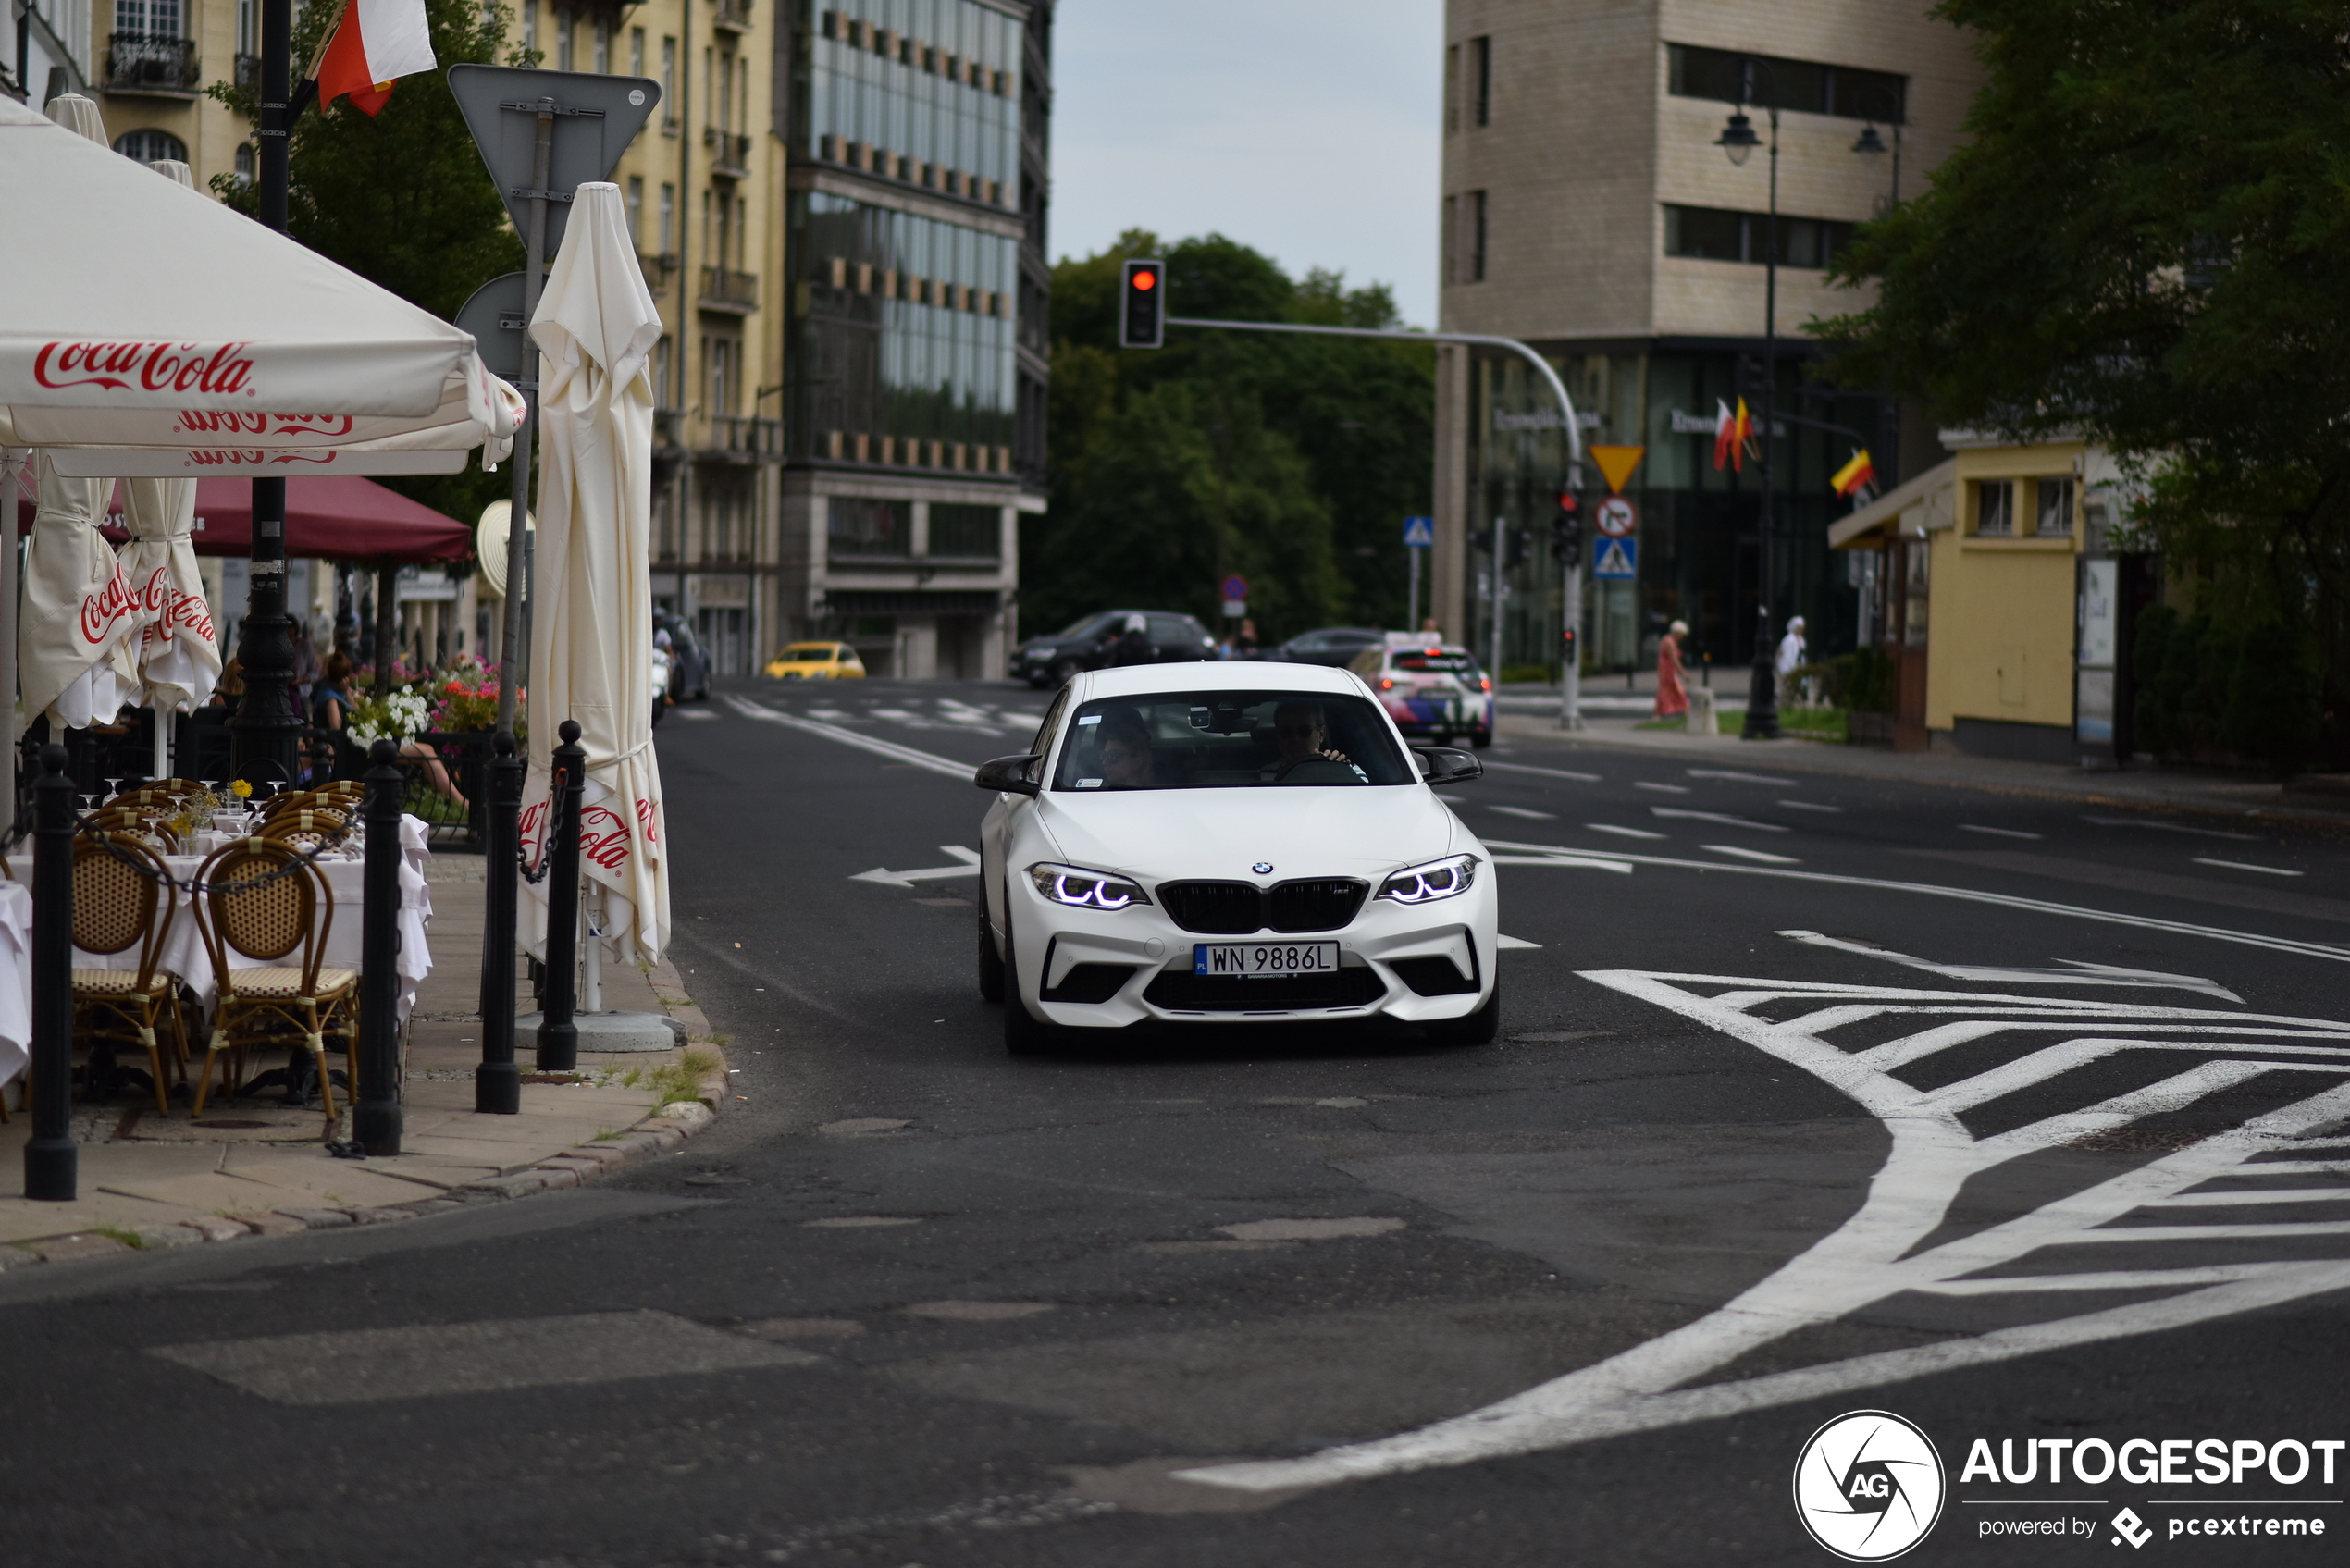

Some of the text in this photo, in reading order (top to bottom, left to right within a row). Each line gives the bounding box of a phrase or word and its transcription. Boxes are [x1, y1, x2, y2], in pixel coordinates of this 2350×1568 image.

[34, 341, 254, 395] Coca-Cola
[1213, 945, 1330, 971] WN 9886L
